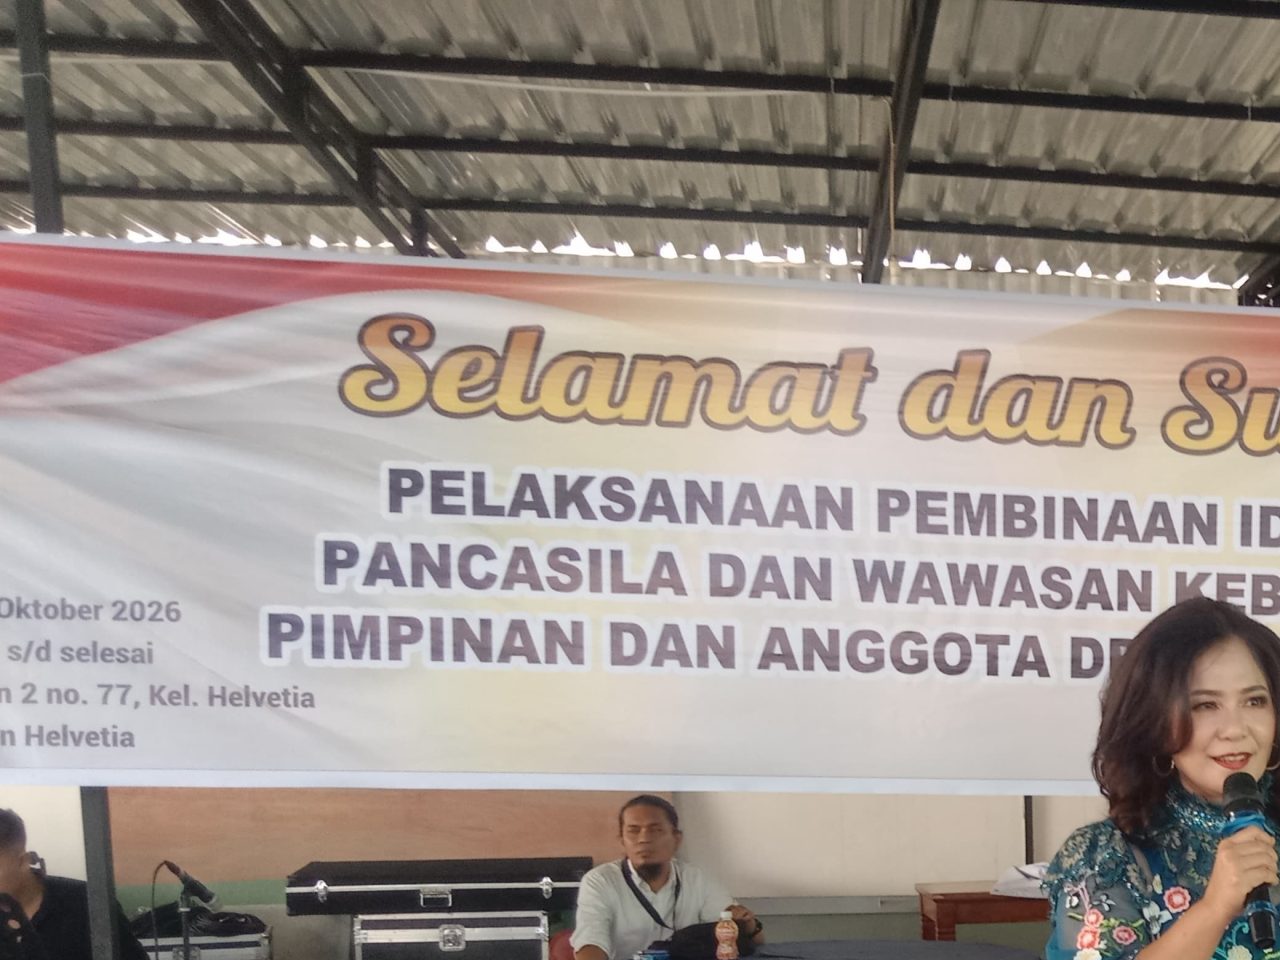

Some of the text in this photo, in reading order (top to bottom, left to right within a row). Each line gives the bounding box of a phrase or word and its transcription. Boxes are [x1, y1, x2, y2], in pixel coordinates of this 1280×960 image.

[338, 311, 878, 438] Selamat
[897, 348, 1136, 450] dan
[388, 468, 853, 532] PELAKSANAAN
[877, 489, 1218, 547] PEMBINAAN
[323, 540, 688, 597] PANCASILA
[709, 553, 832, 602] DAN
[854, 559, 1152, 612] WAWASAN
[0, 597, 182, 622] Oktober 2026
[7, 641, 154, 664] s/d selesai
[267, 612, 585, 665] PIMPINAN
[609, 622, 735, 670] DAN
[757, 629, 1050, 679] ANGGOTA
[21, 683, 38, 704] 2
[46, 687, 88, 706] no.
[97, 684, 141, 709] 77,
[150, 684, 199, 708] Kel.
[208, 686, 315, 708] Helvetia
[25, 725, 136, 747] Helvetia
